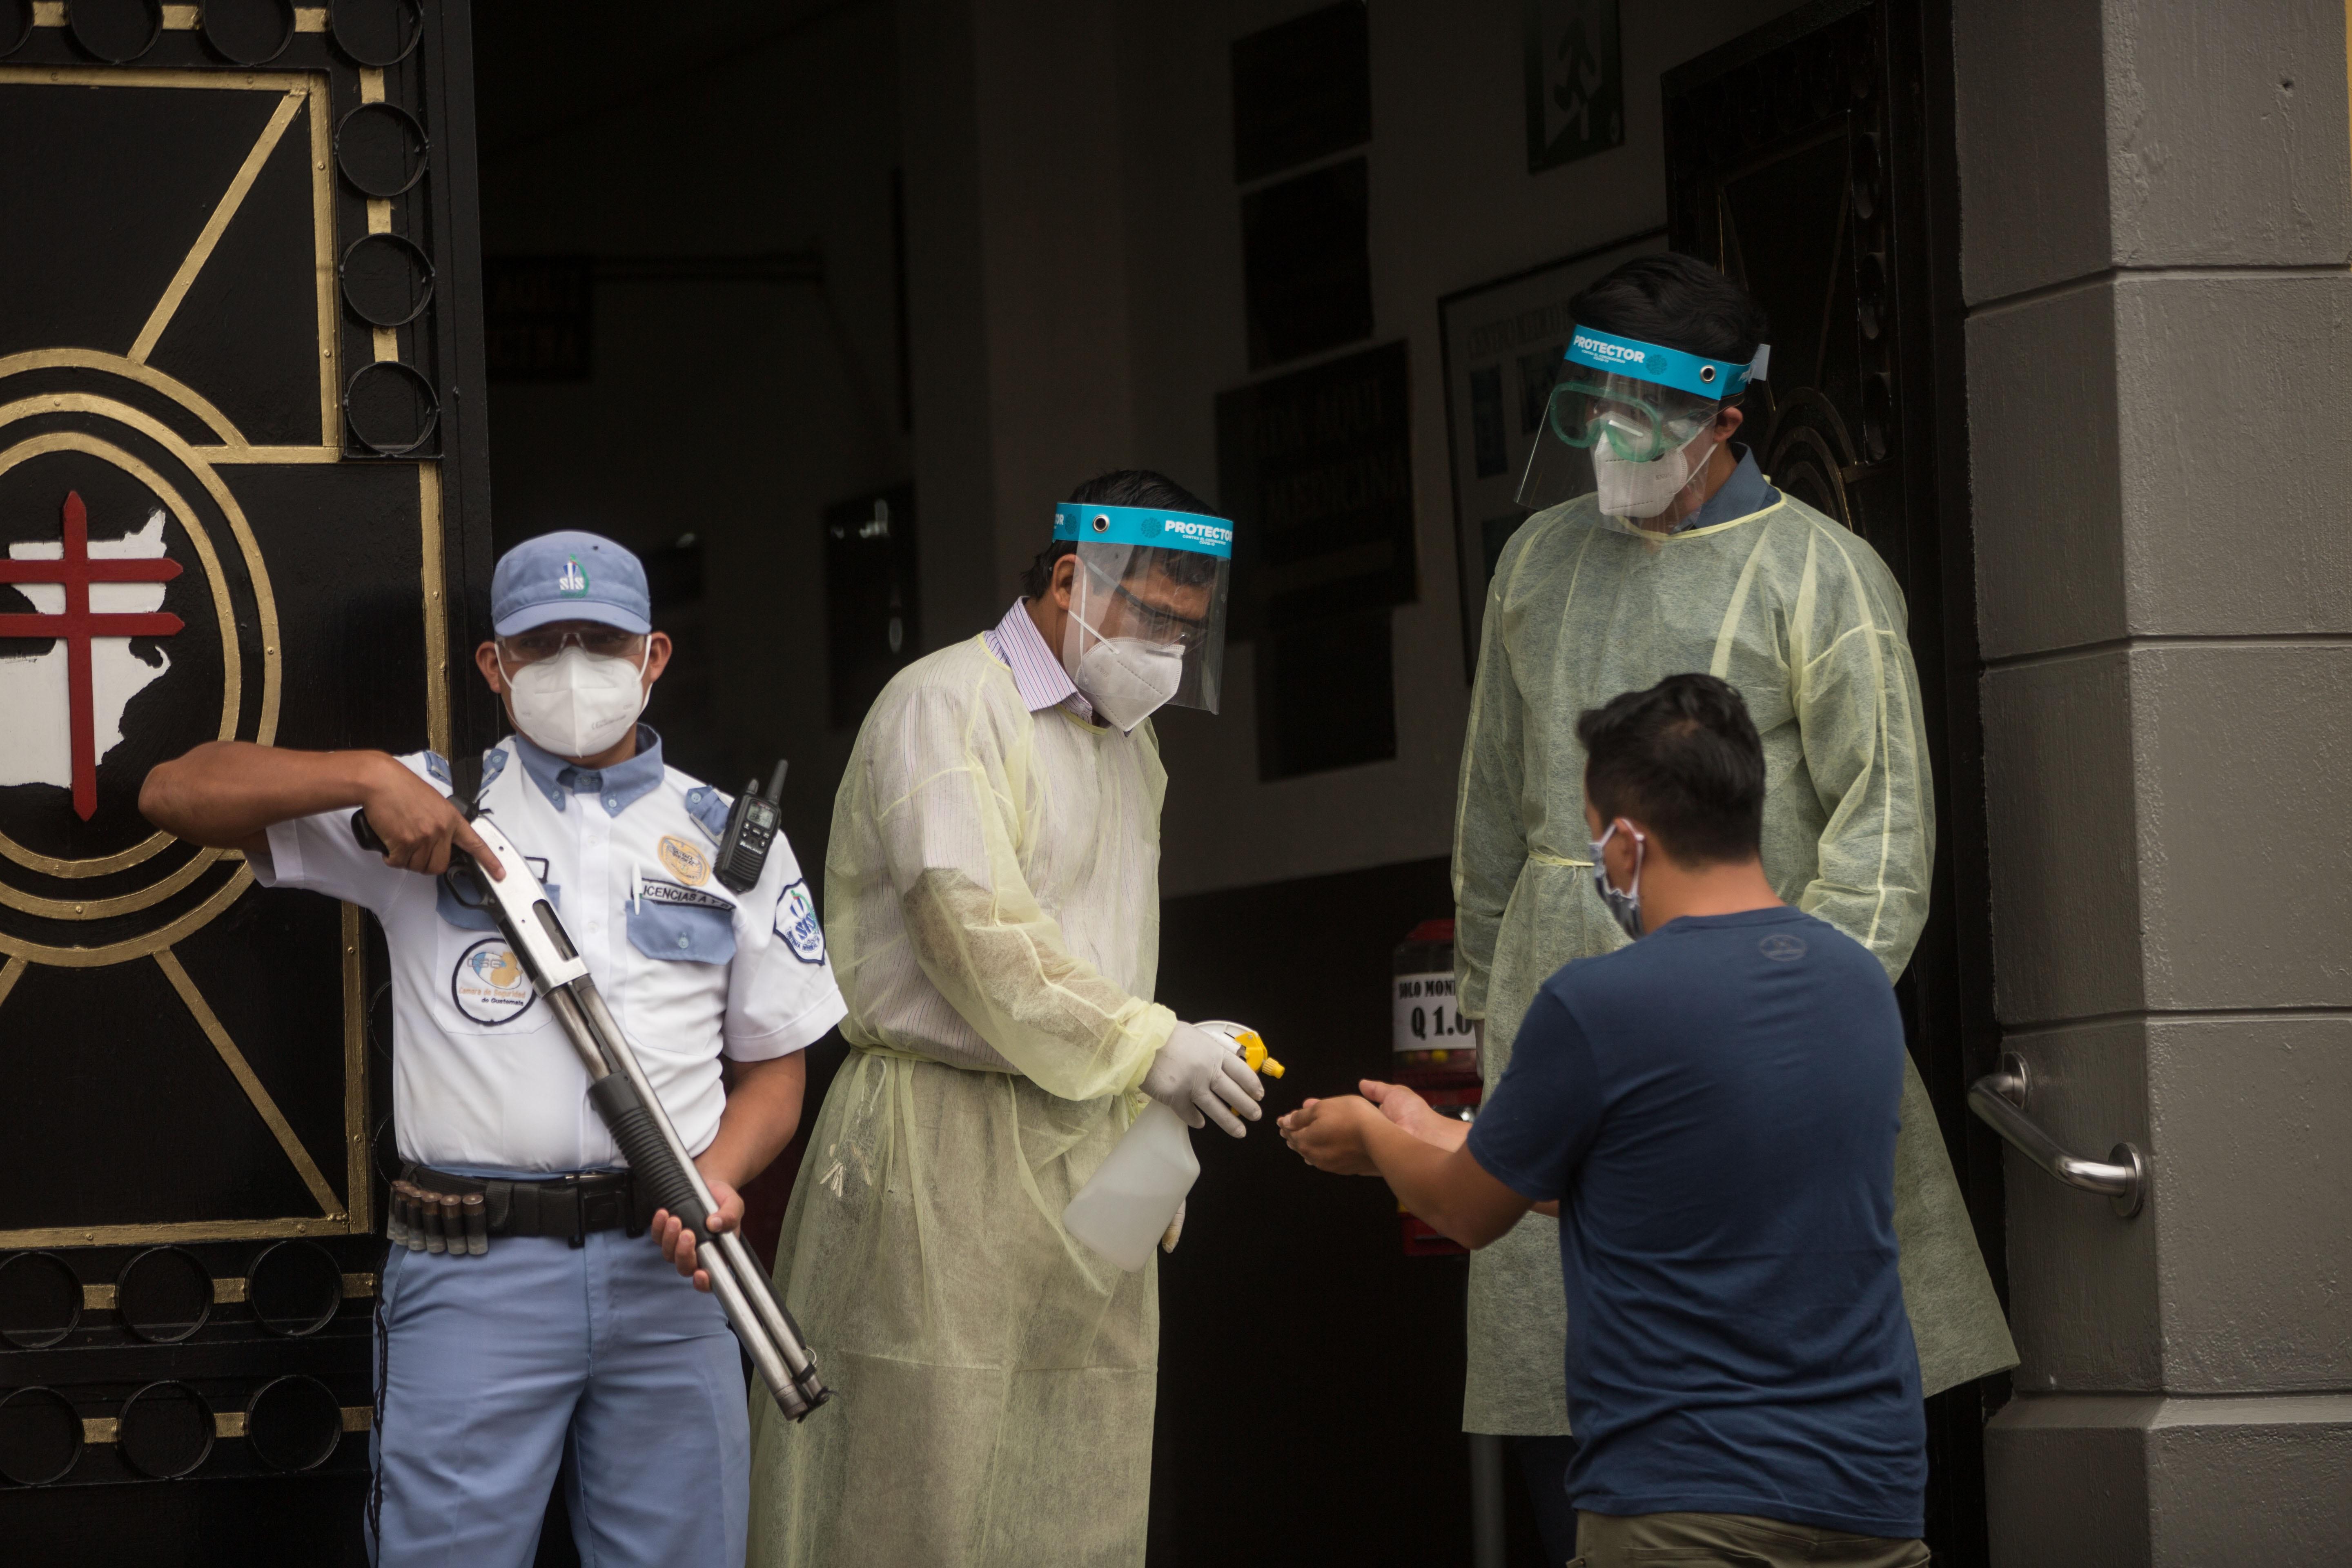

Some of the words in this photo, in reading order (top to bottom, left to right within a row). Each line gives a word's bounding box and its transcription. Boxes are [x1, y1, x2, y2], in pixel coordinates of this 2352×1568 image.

[1573, 335, 1645, 363] PROTECTOR
[1165, 520, 1232, 542] PROTECTOR
[643, 885, 697, 901] ICENCIAS
[1411, 1006, 1426, 1040] Q
